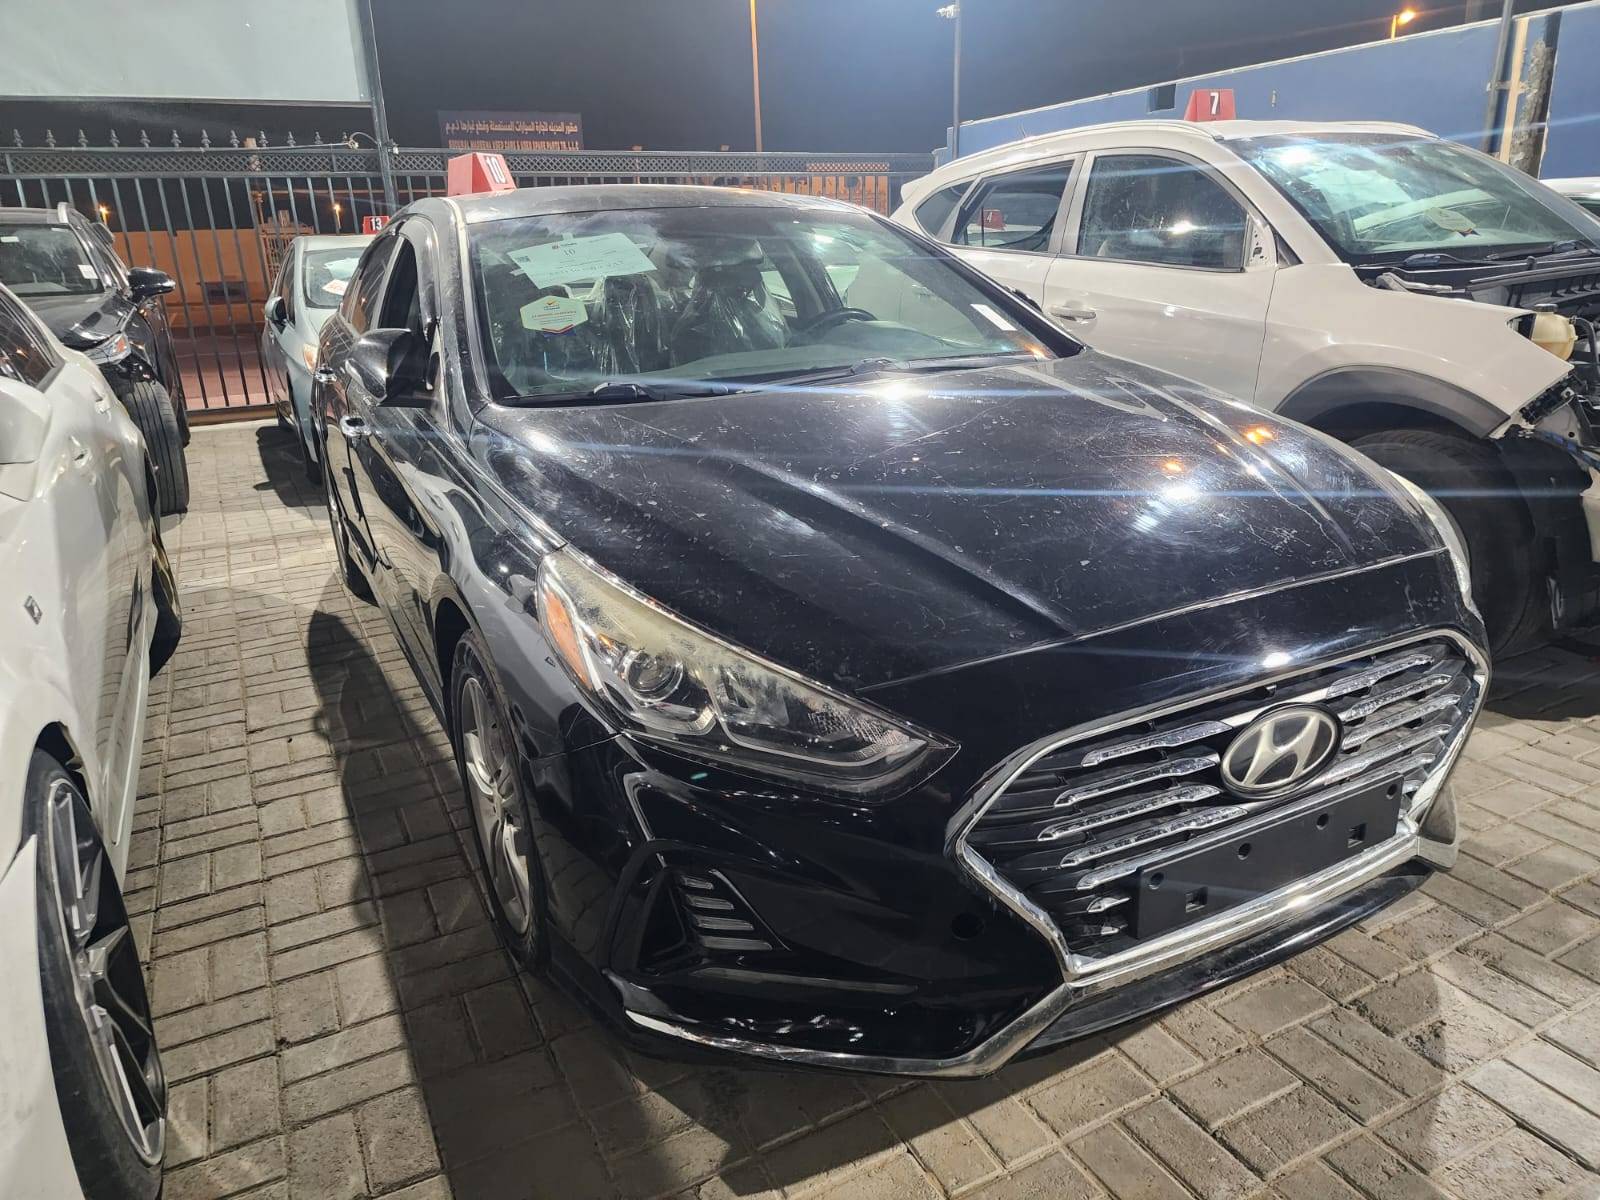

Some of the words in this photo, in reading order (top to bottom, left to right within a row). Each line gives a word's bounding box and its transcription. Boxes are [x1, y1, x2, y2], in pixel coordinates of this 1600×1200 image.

[1210, 92, 1219, 115] 7
[485, 156, 506, 184] 10
[370, 217, 382, 231] 13
